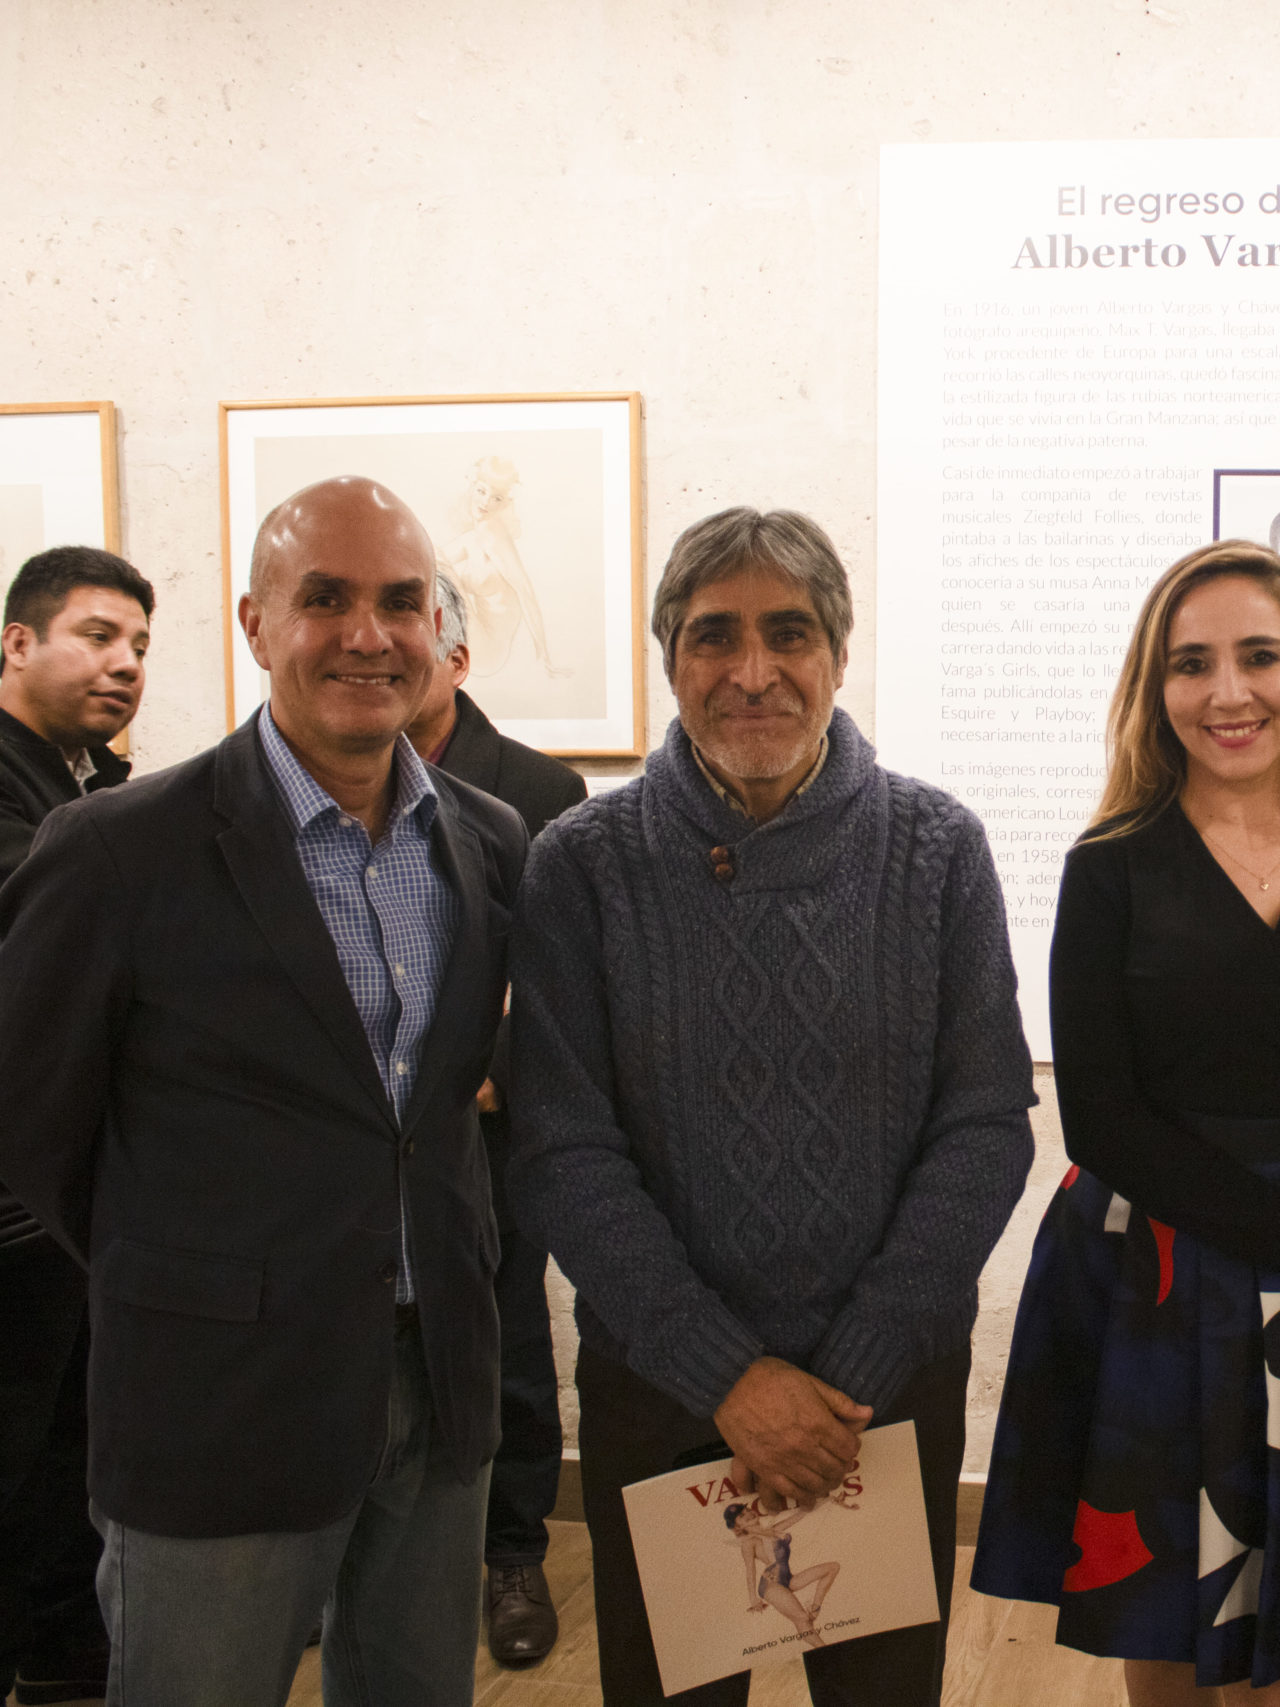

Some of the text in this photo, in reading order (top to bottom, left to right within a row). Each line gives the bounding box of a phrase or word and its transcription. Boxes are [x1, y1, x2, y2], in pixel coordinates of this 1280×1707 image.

[1056, 185, 1086, 216] El
[1100, 189, 1245, 224] regreso
[1011, 233, 1187, 269] Alberto
[943, 302, 963, 316] En
[1022, 305, 1041, 316] un
[1048, 303, 1088, 318] joven
[1097, 301, 1153, 314] Alberto
[1162, 301, 1212, 316] Vargas
[1221, 303, 1229, 315] y
[1108, 323, 1140, 337] Max
[1223, 321, 1275, 339] llegaba
[943, 345, 975, 361] York
[984, 344, 1068, 361] procedente
[1076, 344, 1095, 359] de
[1104, 345, 1156, 361] Europa
[1165, 347, 1197, 361] para
[1206, 348, 1232, 359] una
[943, 369, 1002, 382] recorrió
[1006, 368, 1025, 381] las
[1029, 368, 1069, 381] calles
[1180, 368, 1227, 383] quedó
[943, 391, 955, 404] la
[960, 390, 1029, 404] estilizada
[1034, 390, 1076, 406] figura
[1082, 390, 1100, 403] de
[1106, 389, 1126, 403] las
[1132, 389, 1176, 403] rubias
[943, 412, 971, 426] vida
[977, 414, 1004, 428] que
[1008, 414, 1024, 425] se
[1067, 414, 1084, 425] en
[1089, 411, 1101, 425] la
[1106, 411, 1142, 425] Gran
[1249, 414, 1276, 427] que
[943, 435, 981, 450] pesar
[986, 434, 1004, 448] de
[1008, 434, 1019, 447] la
[1022, 434, 1084, 450] negativa
[942, 465, 1201, 482] Casi de inmediato empezó a trabajar
[942, 491, 974, 504] para
[992, 488, 1004, 501] la
[1109, 488, 1127, 501] de
[1145, 489, 1202, 502] revistas
[942, 510, 1012, 523] musicales
[1023, 509, 1082, 527] Ziegfeld
[1155, 510, 1202, 524] donde
[942, 531, 1202, 548] pintaba a las bailarinas y diseñaba
[942, 553, 1070, 567] los afiches de los
[1017, 578, 1024, 589] a
[1029, 578, 1045, 590] su
[1050, 578, 1088, 589] musa
[1091, 576, 1130, 589] Anna
[941, 597, 1130, 614] quien se casaría una
[1040, 619, 1097, 636] empezó
[1104, 622, 1120, 633] su
[941, 642, 993, 655] carrera
[997, 641, 1042, 655] dando
[1045, 641, 1075, 655] vida
[1078, 644, 1086, 655] a
[1090, 641, 1109, 656] las
[1048, 666, 1075, 680] que
[1083, 664, 1095, 677] lo
[941, 686, 1108, 700] fama publicándolas en
[941, 706, 996, 722] Esquire
[1011, 709, 1019, 721] y
[941, 728, 1055, 742] necesariamente
[1059, 732, 1066, 742] a
[1071, 729, 1082, 742] la
[941, 762, 964, 775] Las
[968, 762, 1036, 778] imágenes
[1040, 763, 1106, 779] reproduc
[1011, 831, 1041, 843] para
[998, 852, 1014, 862] en
[1017, 895, 1025, 908] y
[1030, 893, 1057, 909] hoy
[1032, 918, 1050, 928] en
[742, 1639, 777, 1656] Alberto
[780, 1629, 814, 1643] Vargas
[824, 1616, 861, 1630] Chávez
